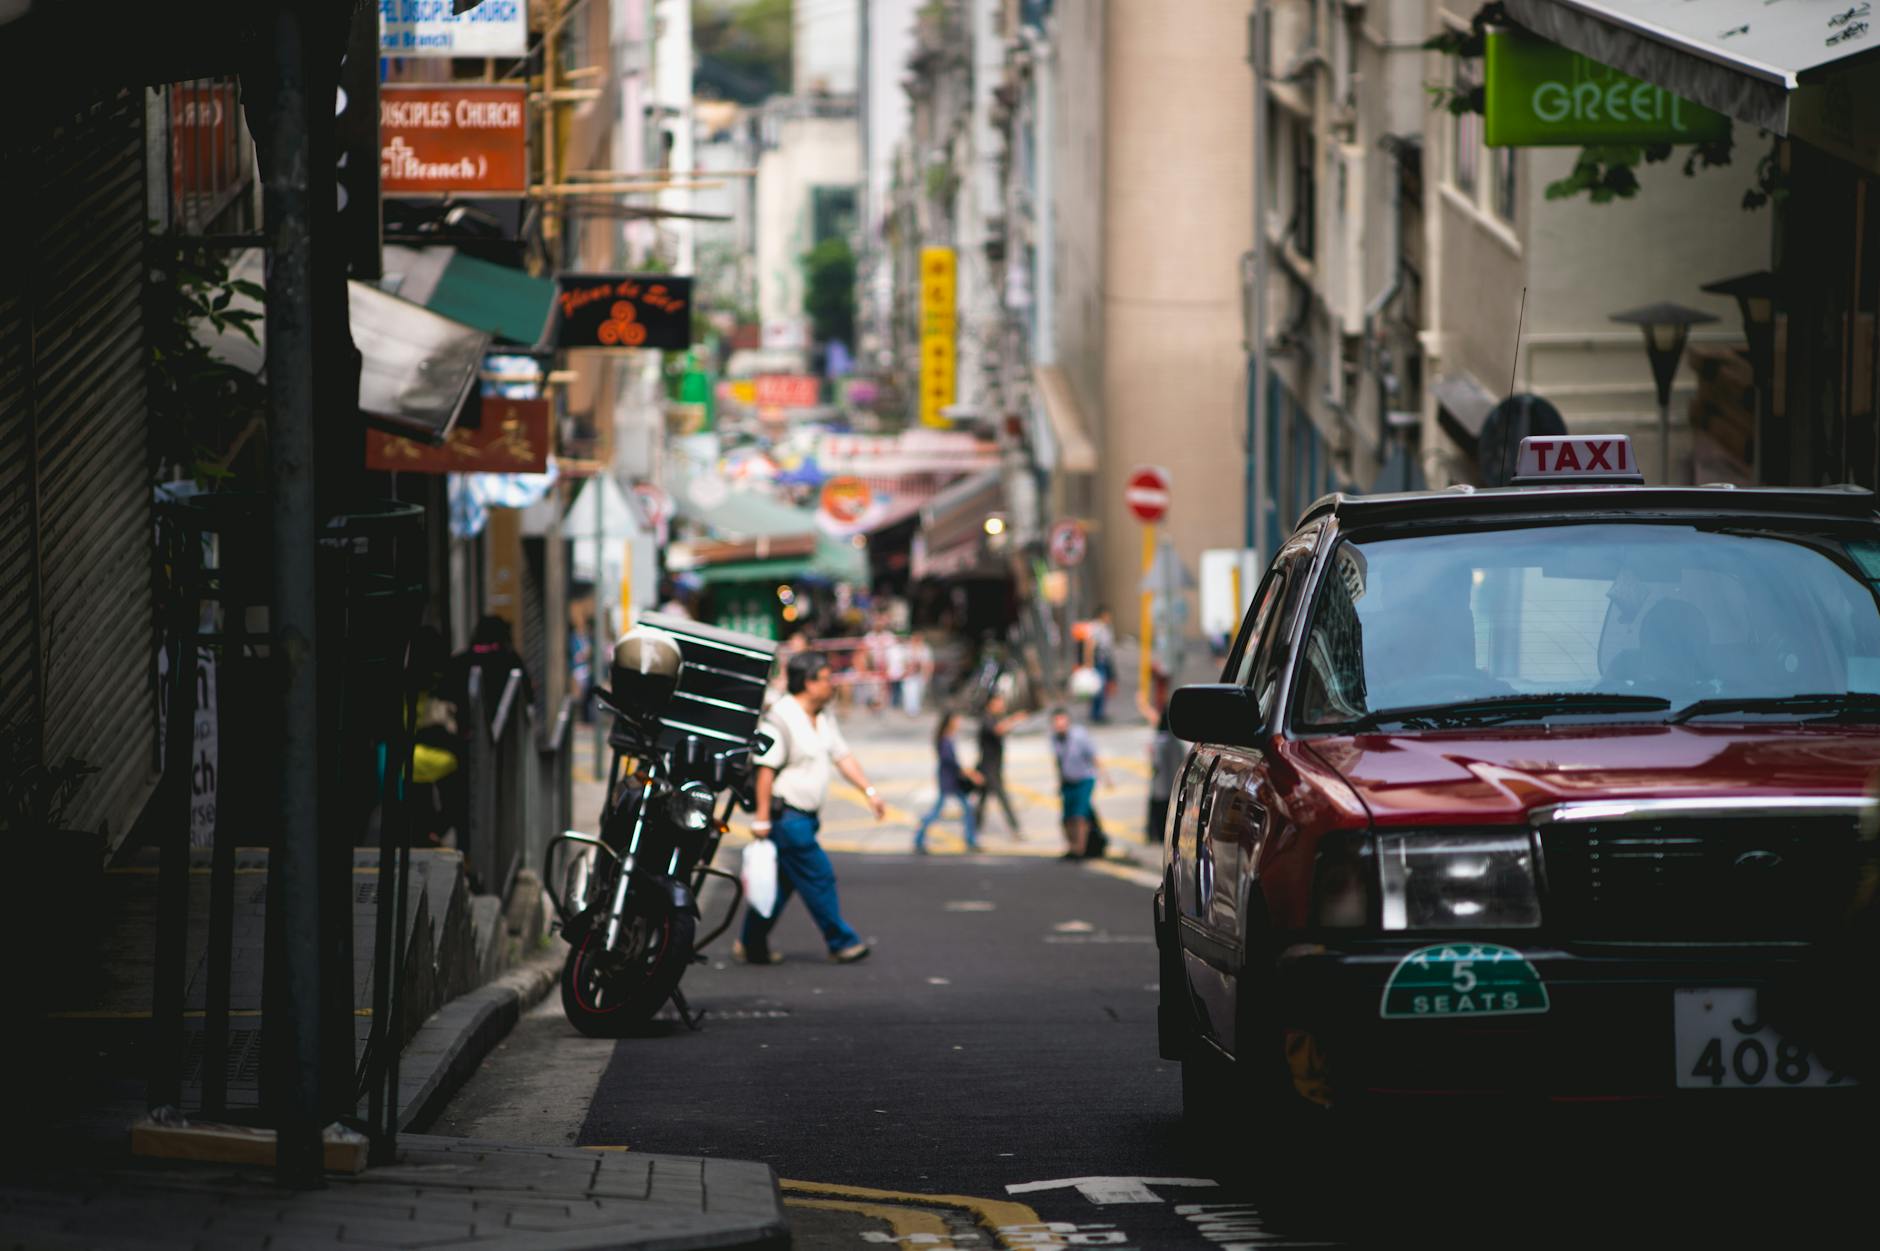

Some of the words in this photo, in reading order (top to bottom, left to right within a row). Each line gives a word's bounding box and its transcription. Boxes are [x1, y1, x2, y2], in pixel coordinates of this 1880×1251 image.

[1530, 440, 1627, 472] TAXI
[1451, 960, 1478, 993] 5
[1413, 991, 1520, 1014] SEATS
[1691, 1037, 1842, 1086] 408
